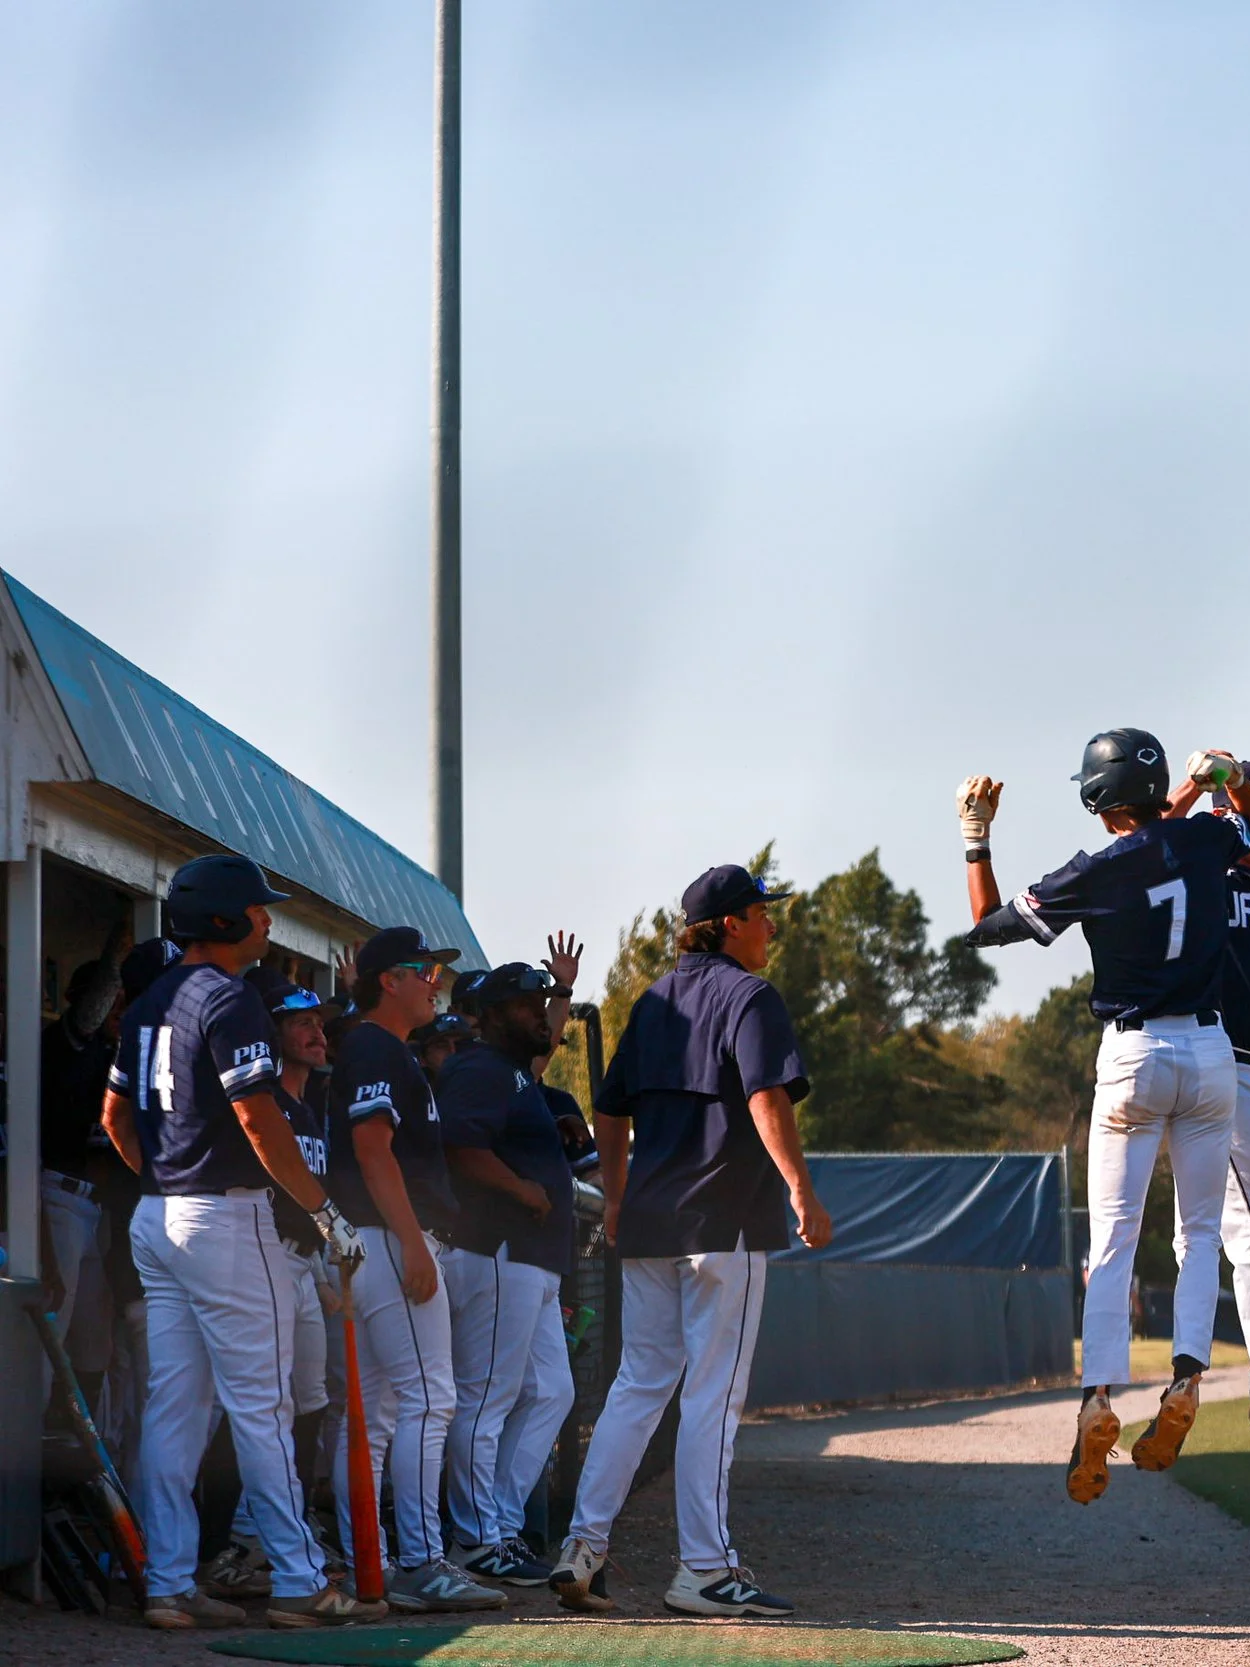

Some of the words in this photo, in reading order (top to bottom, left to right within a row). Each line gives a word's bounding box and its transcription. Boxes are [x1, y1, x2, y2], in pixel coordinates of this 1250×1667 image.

[1148, 783, 1155, 795] 7
[1147, 876, 1187, 961] 7
[139, 1025, 175, 1112] 14
